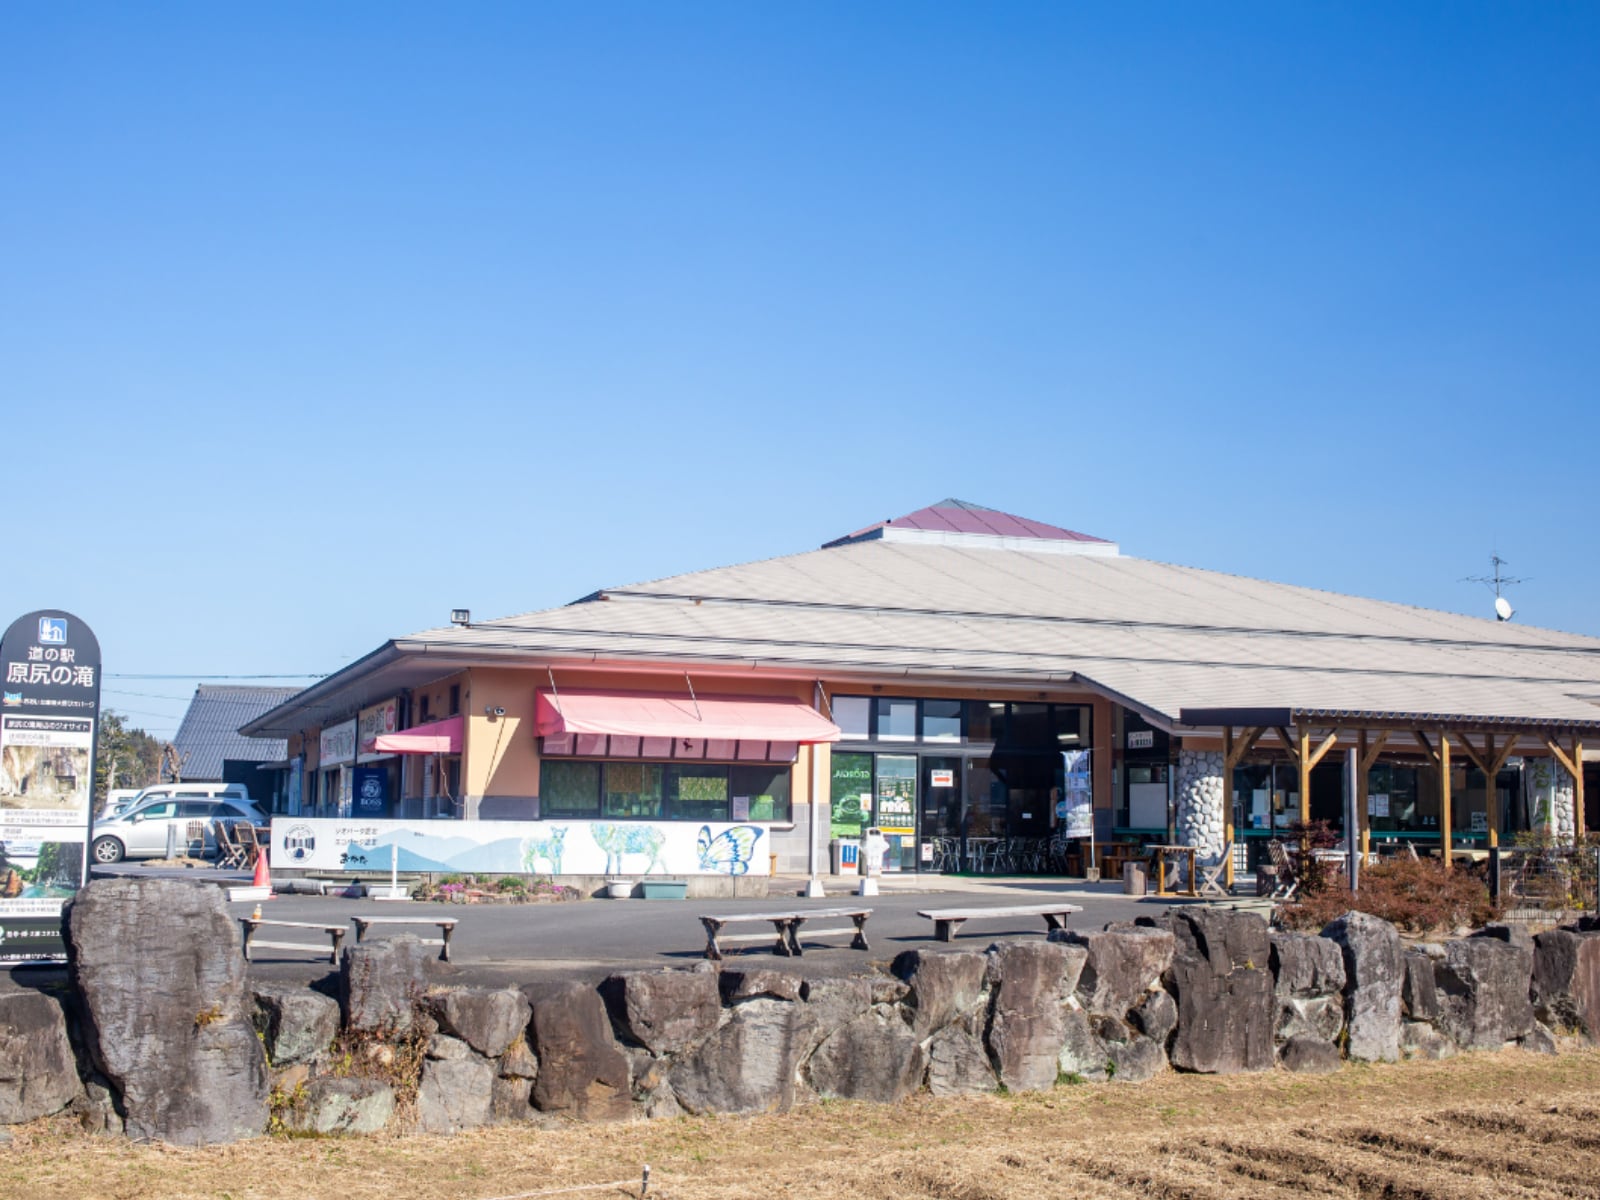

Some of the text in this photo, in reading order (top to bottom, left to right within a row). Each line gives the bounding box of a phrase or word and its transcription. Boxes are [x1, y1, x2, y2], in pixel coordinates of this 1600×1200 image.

[28, 646, 75, 663] 道の駅
[6, 662, 95, 688] 原尻の滝
[360, 798, 382, 806] BOSS
